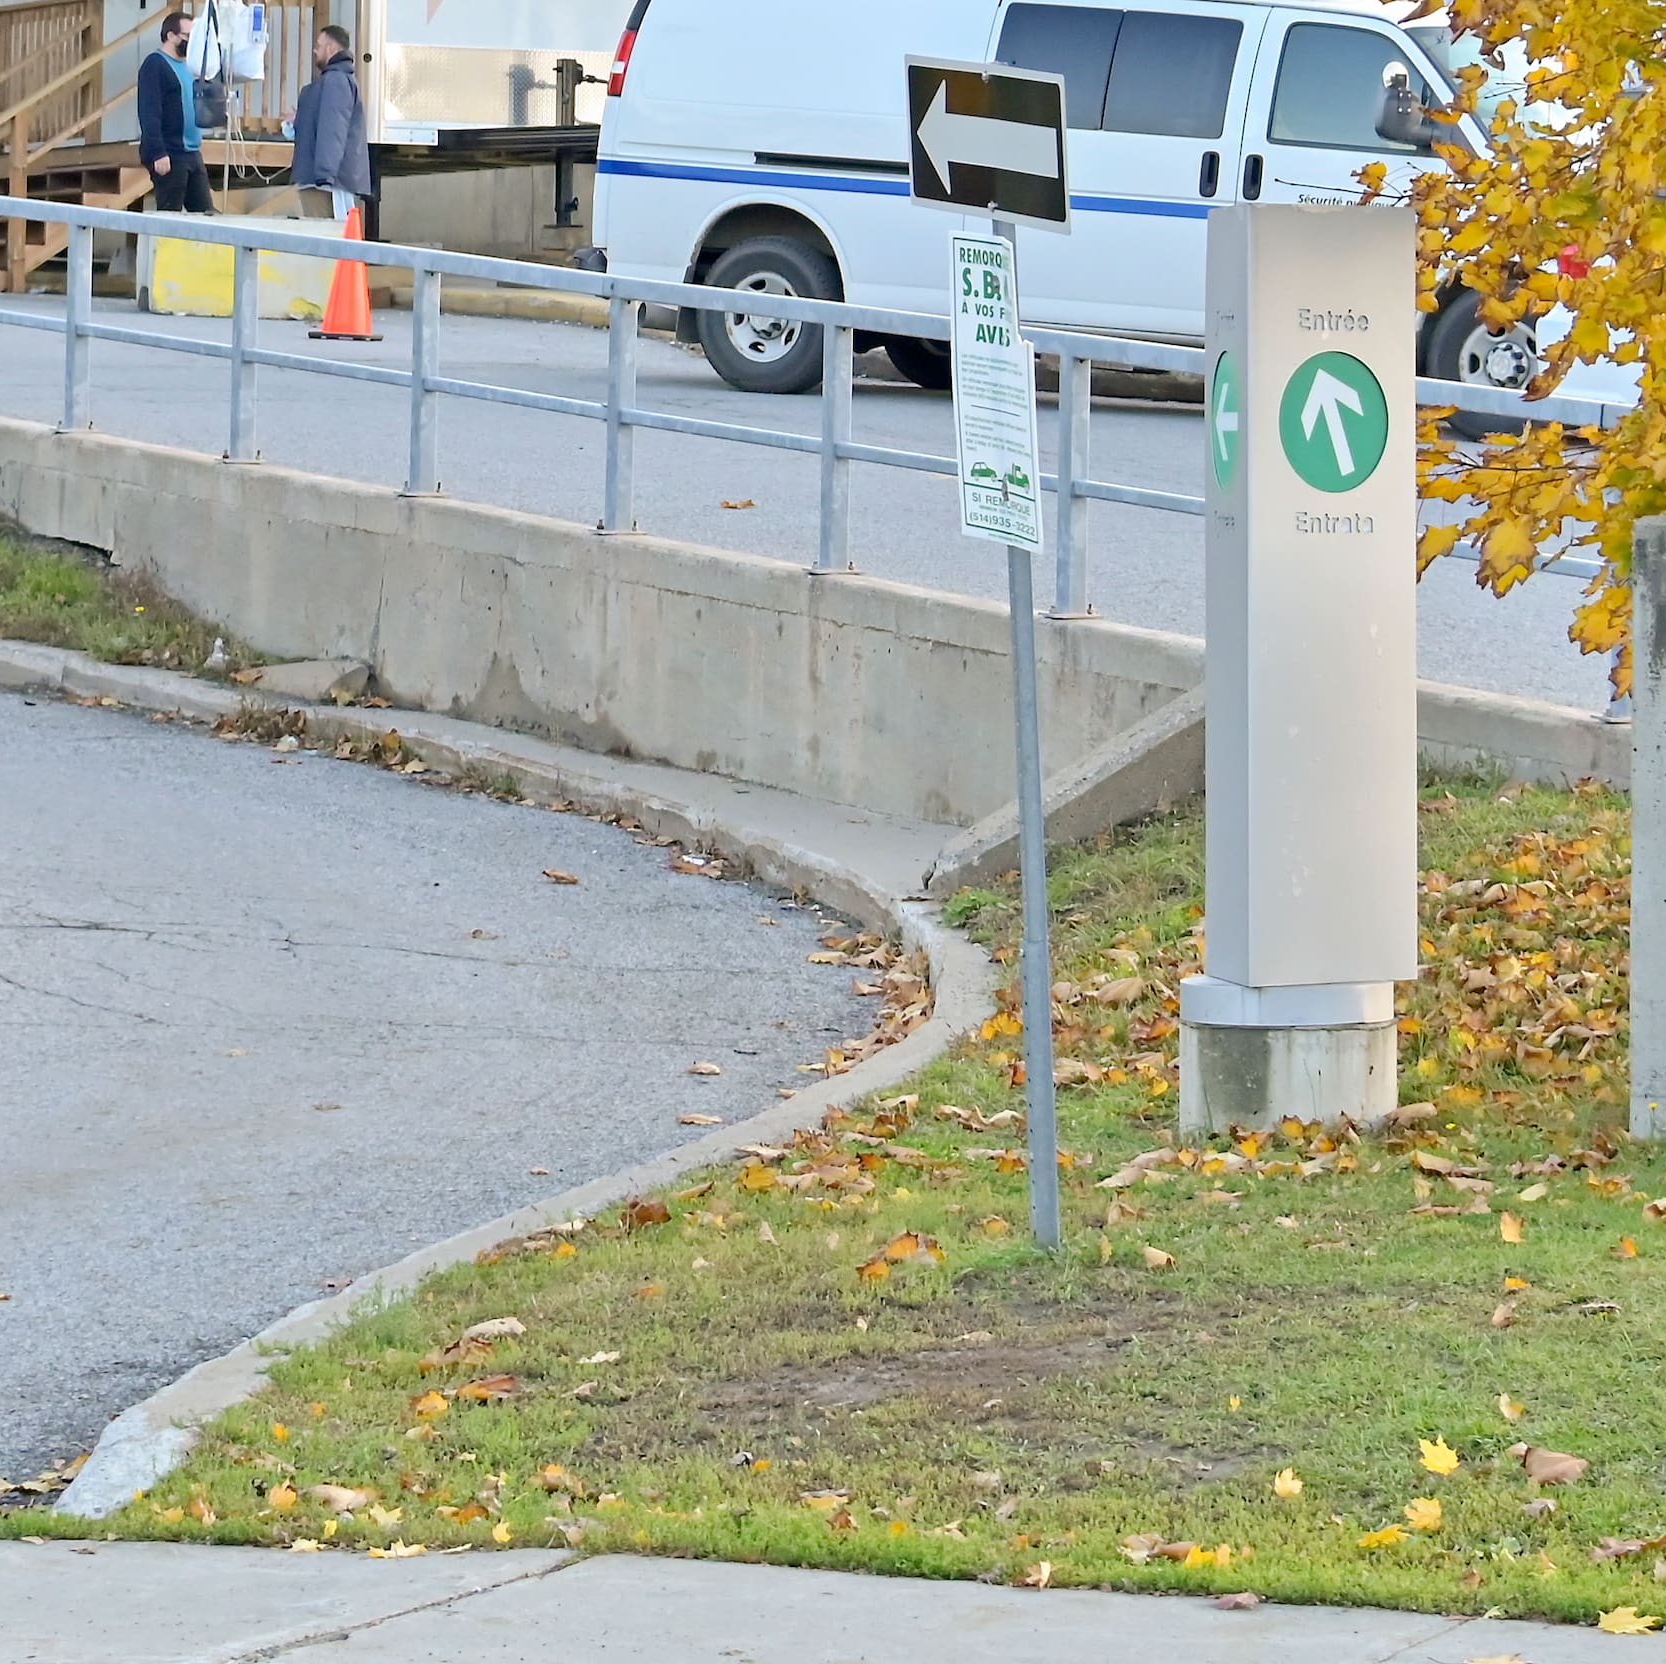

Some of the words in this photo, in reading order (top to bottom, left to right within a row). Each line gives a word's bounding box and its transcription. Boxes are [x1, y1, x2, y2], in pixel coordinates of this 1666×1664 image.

[1297, 193, 1343, 206] Sécurité
[959, 247, 1003, 269] REMORQ
[975, 303, 994, 318] VOS
[1297, 307, 1371, 333] Entrée
[1295, 511, 1375, 535] Entrata
